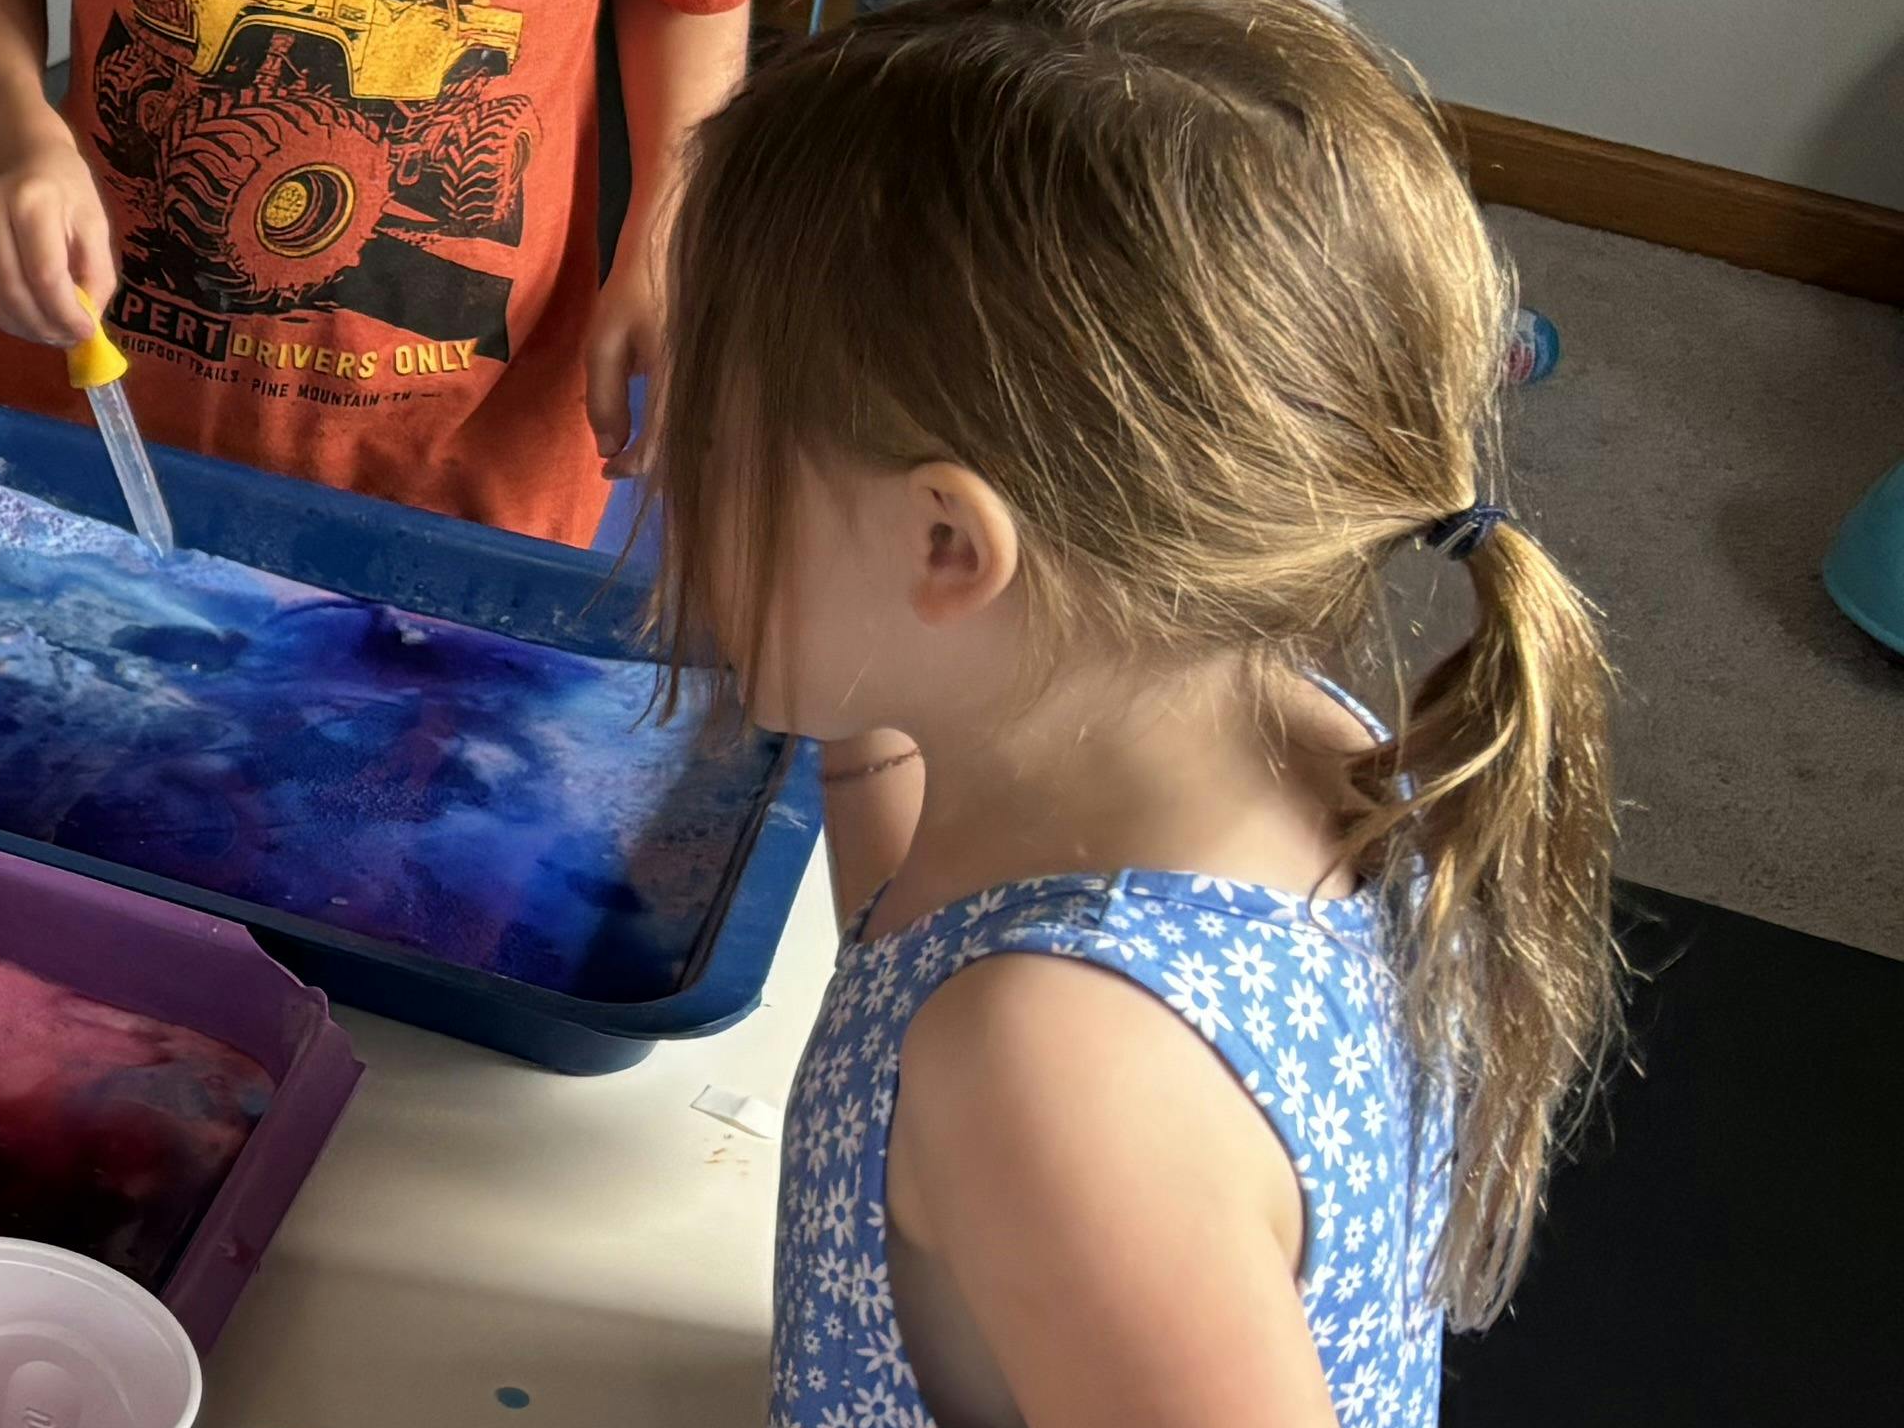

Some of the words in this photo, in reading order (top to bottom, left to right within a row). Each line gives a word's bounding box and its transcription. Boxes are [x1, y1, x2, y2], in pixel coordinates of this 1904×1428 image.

[119, 291, 226, 355] PERT
[230, 332, 379, 380] DRIVERS
[392, 340, 477, 375] ONLY
[120, 334, 185, 365] BIGFOOT
[190, 359, 240, 384] TRAILS
[250, 378, 289, 398] PINE
[296, 383, 380, 407] MOUNTAIN
